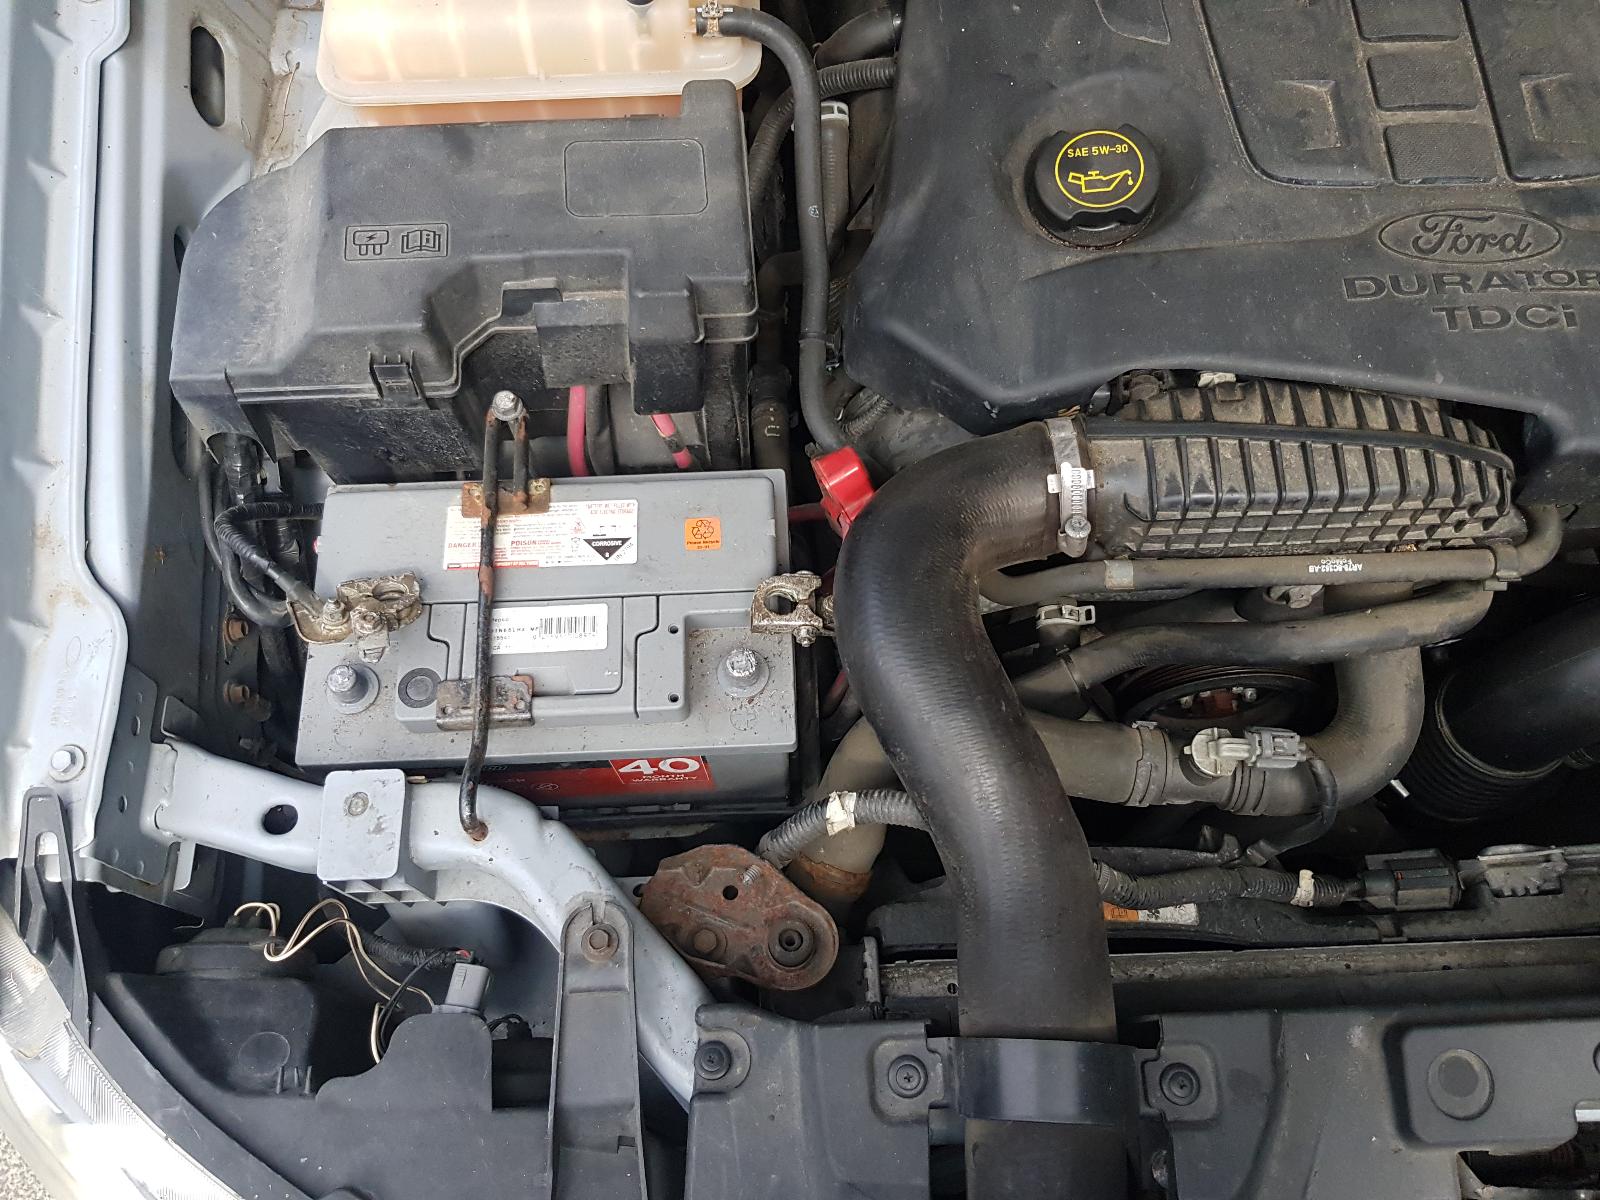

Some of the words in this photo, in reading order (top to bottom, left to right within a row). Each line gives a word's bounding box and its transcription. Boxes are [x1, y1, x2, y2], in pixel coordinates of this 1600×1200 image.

[1067, 148, 1089, 158] SAE
[1091, 143, 1129, 156] 5W-30
[1411, 214, 1532, 256] Ford
[1432, 303, 1578, 332] TDCi
[618, 757, 700, 775] 40
